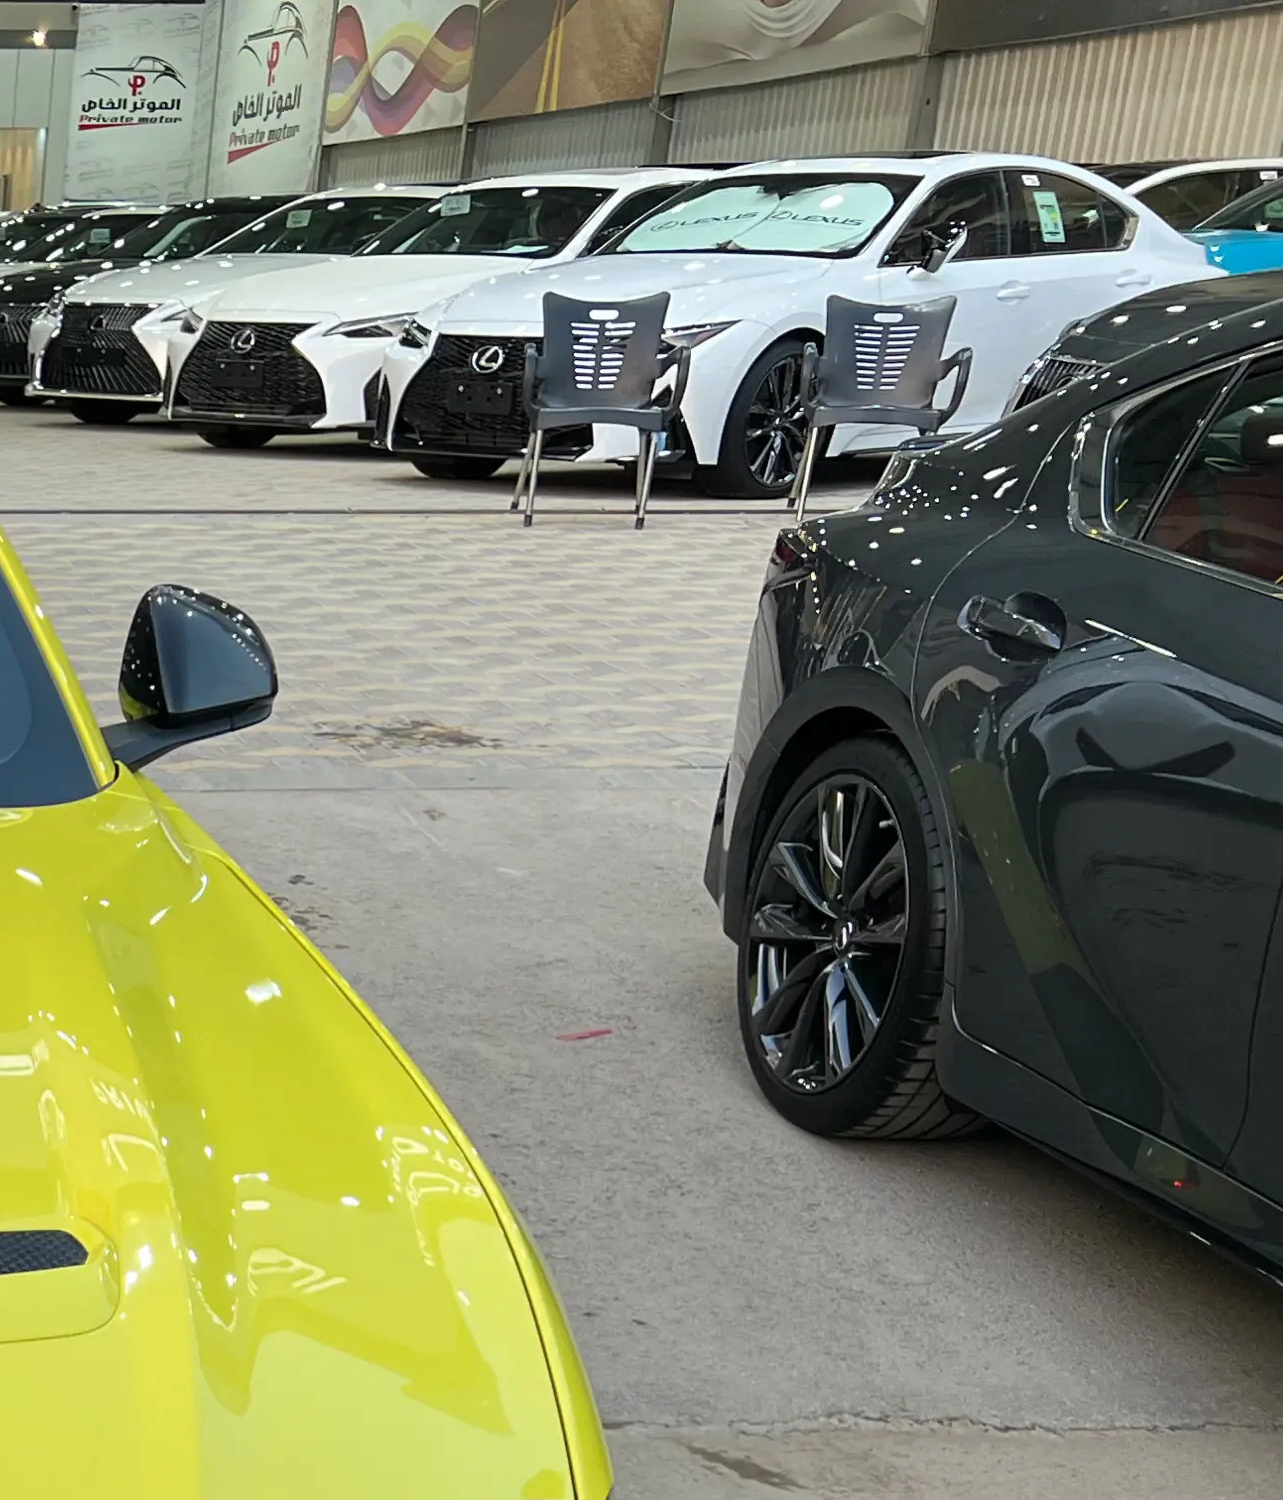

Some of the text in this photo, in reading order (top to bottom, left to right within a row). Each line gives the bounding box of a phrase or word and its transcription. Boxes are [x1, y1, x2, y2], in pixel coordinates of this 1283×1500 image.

[81, 98, 181, 113] الموتر الخاص
[232, 84, 301, 126] الموتر الخاص
[79, 114, 182, 123] Private motor
[229, 123, 300, 147] Private motor
[679, 211, 759, 227] LEXUS
[790, 213, 864, 227] LEXUS
